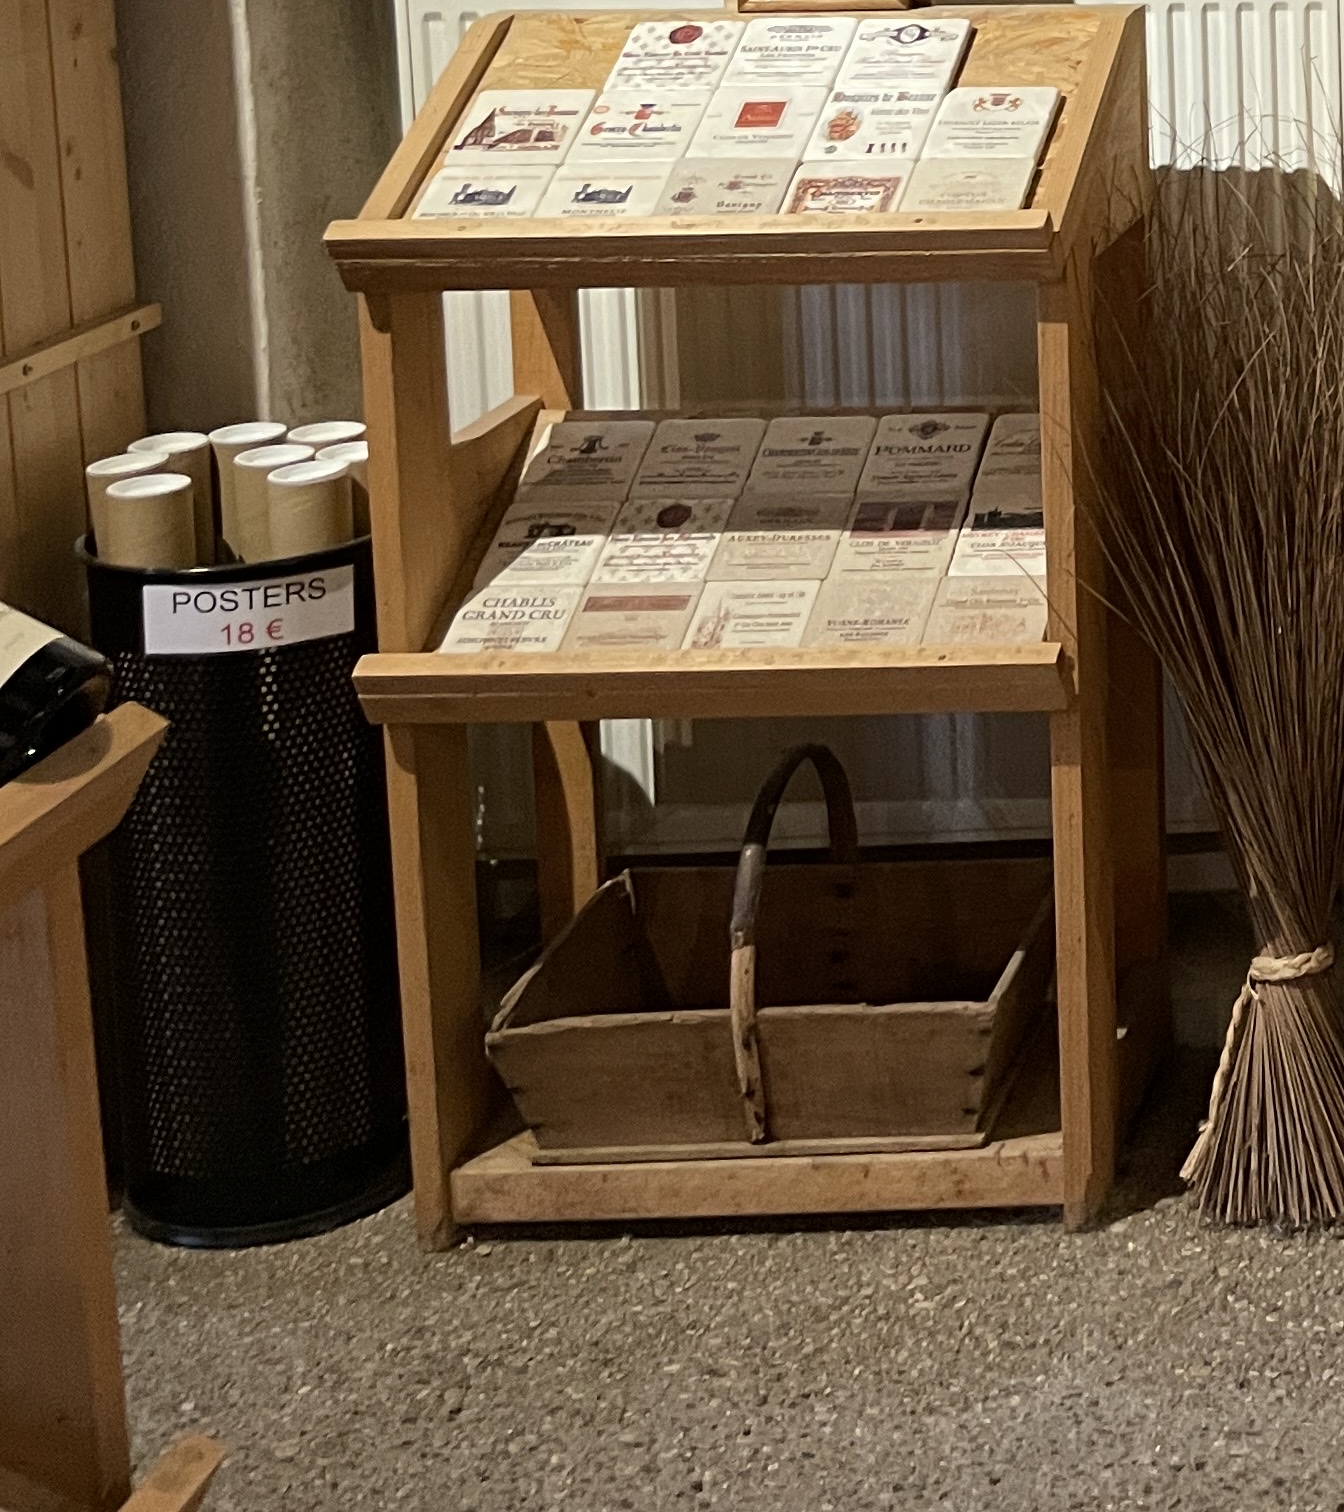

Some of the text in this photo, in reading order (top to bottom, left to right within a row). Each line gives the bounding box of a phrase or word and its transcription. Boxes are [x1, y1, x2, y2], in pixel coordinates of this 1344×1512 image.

[873, 443, 972, 457] POMMARD
[172, 577, 327, 615] POSTERS
[483, 597, 557, 608] CHABLIS
[462, 609, 567, 621] GRAND CRU
[220, 619, 284, 646] 18 €
